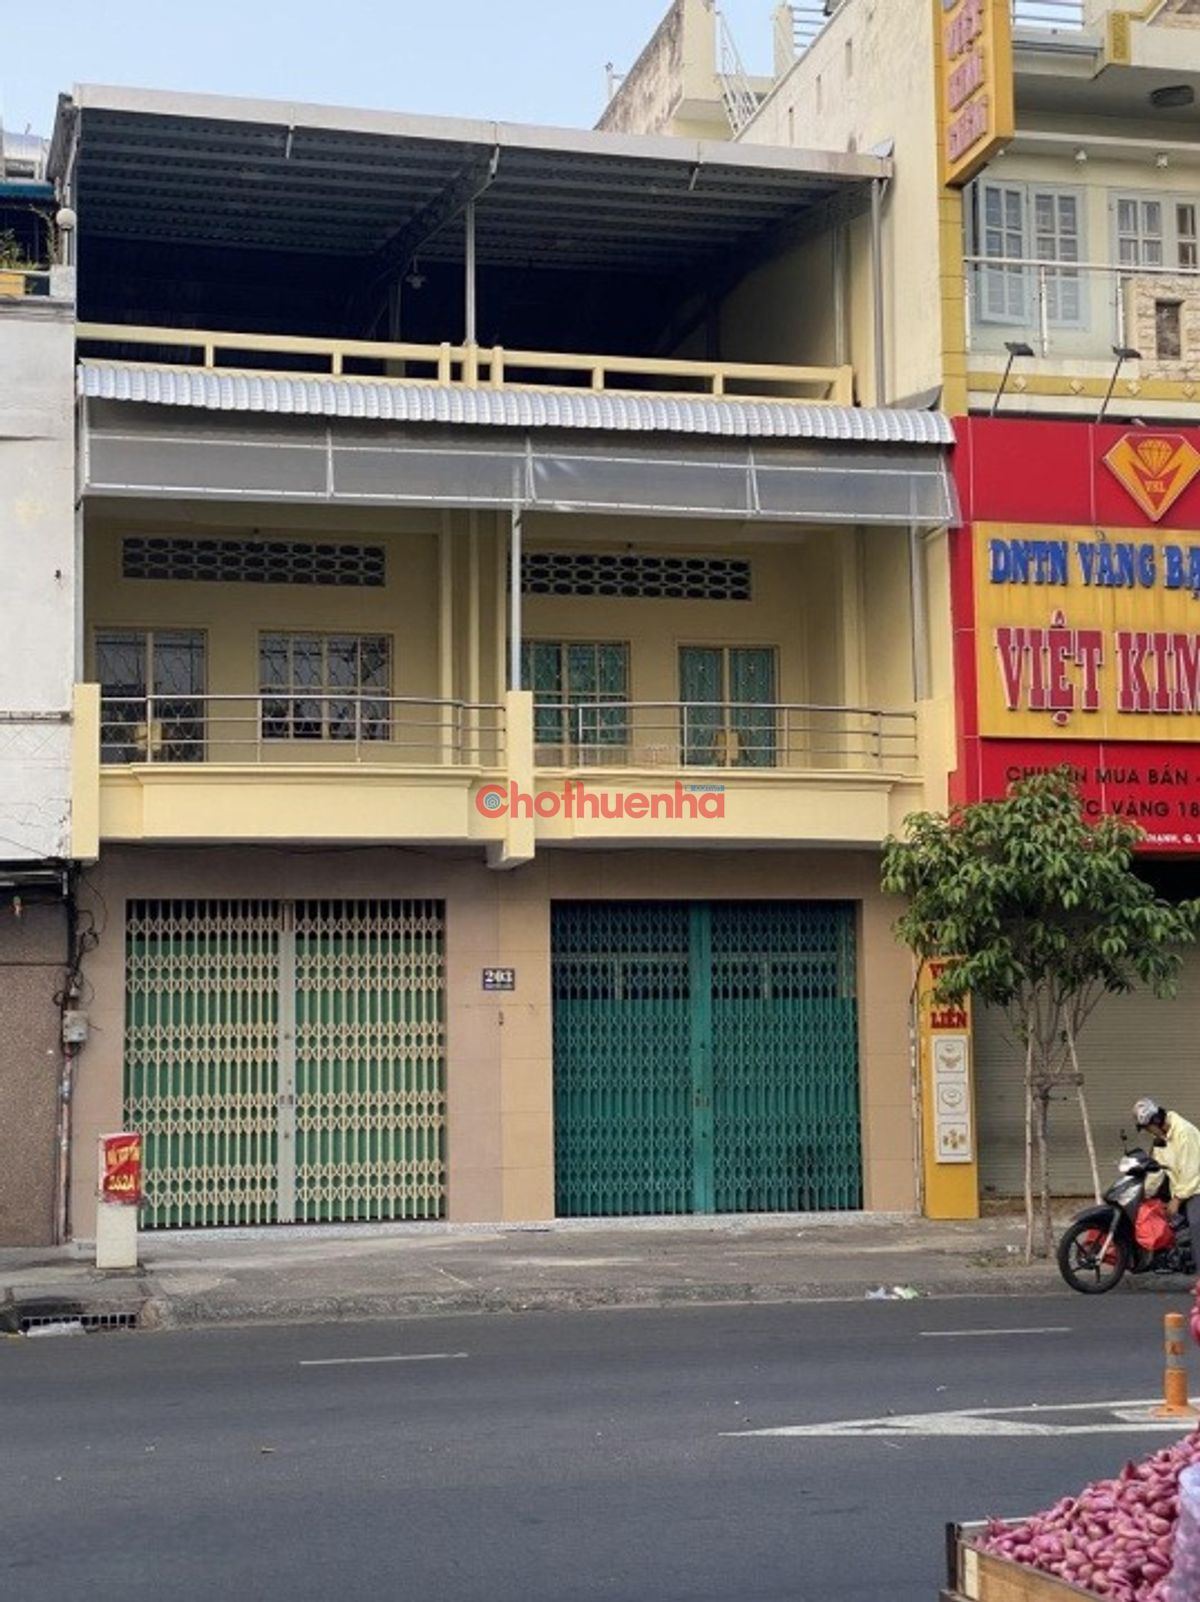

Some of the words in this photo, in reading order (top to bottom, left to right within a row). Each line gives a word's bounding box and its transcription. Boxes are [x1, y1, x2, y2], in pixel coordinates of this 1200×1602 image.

[989, 538, 1069, 586] DNTN
[1075, 531, 1156, 588] VÀNG
[994, 609, 1104, 727] VIỆT
[1115, 631, 1200, 715] KIM
[1006, 765, 1087, 783] CHUN
[1095, 768, 1139, 784] MUA
[1147, 762, 1188, 785] BÁN
[1112, 795, 1170, 817] VÀNG
